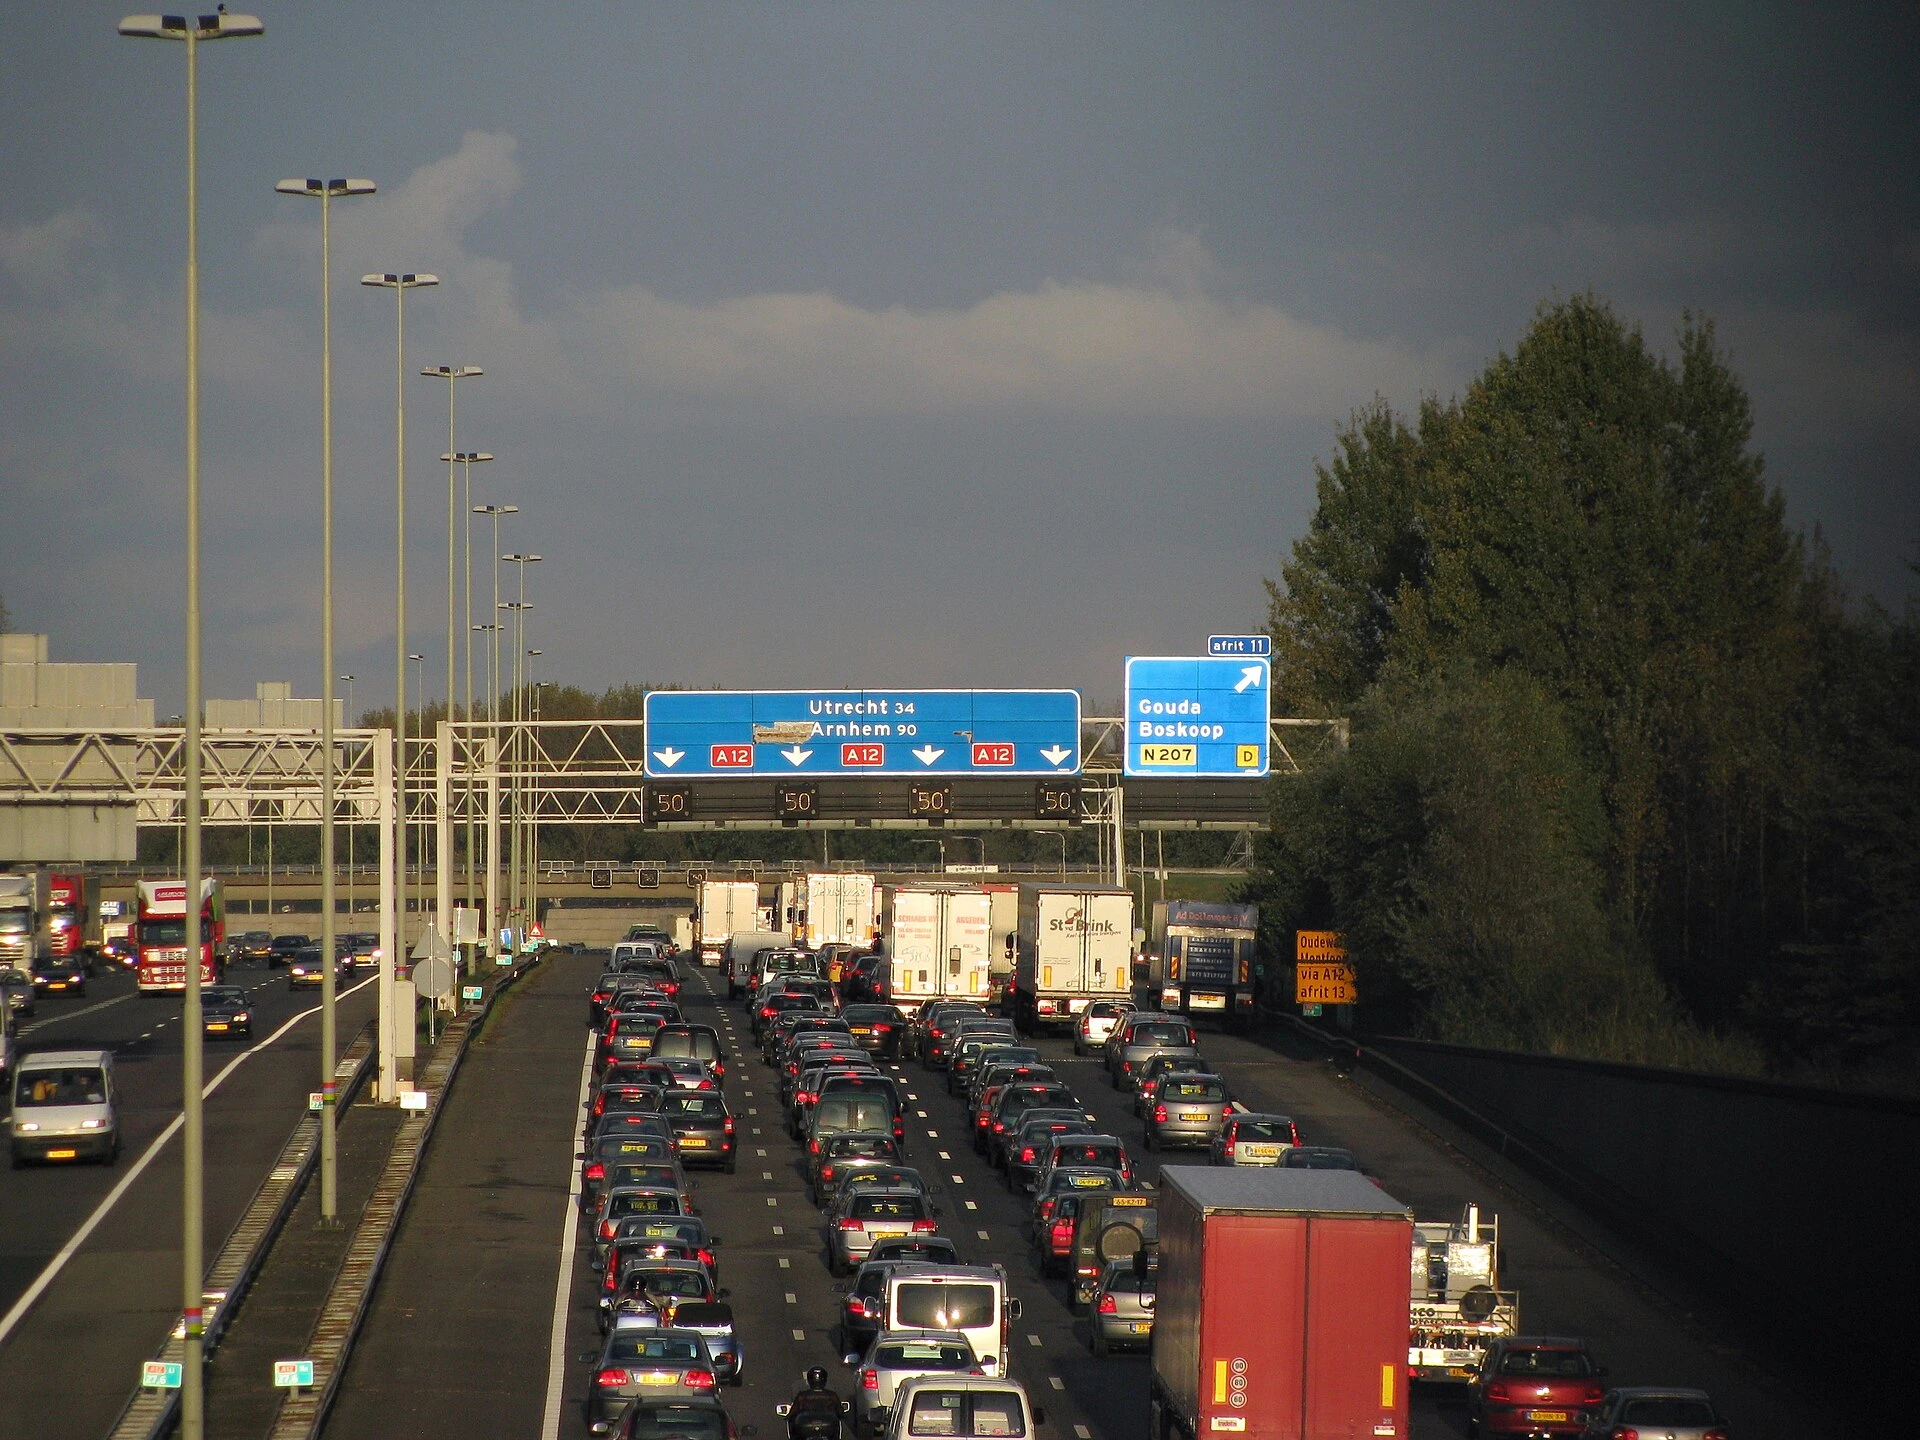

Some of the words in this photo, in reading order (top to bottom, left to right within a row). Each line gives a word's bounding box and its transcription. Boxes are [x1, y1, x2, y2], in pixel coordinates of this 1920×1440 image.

[1213, 641, 1244, 651] afrit
[1250, 640, 1263, 651] 11
[809, 699, 888, 715] Utrecht
[894, 702, 915, 715] 34
[1138, 699, 1201, 715] Gouda
[810, 721, 891, 737] Arnhem
[896, 724, 917, 736] 90
[1138, 721, 1224, 740] Boskoop
[1243, 750, 1253, 762] D
[658, 794, 684, 812] 50
[785, 792, 811, 811] 50
[918, 791, 944, 810] 50
[1045, 791, 1071, 810] 50
[1049, 919, 1064, 931] St
[1301, 967, 1319, 980] via
[1323, 968, 1345, 980] A12
[1300, 985, 1329, 998] afrit
[1332, 986, 1345, 998] 13
